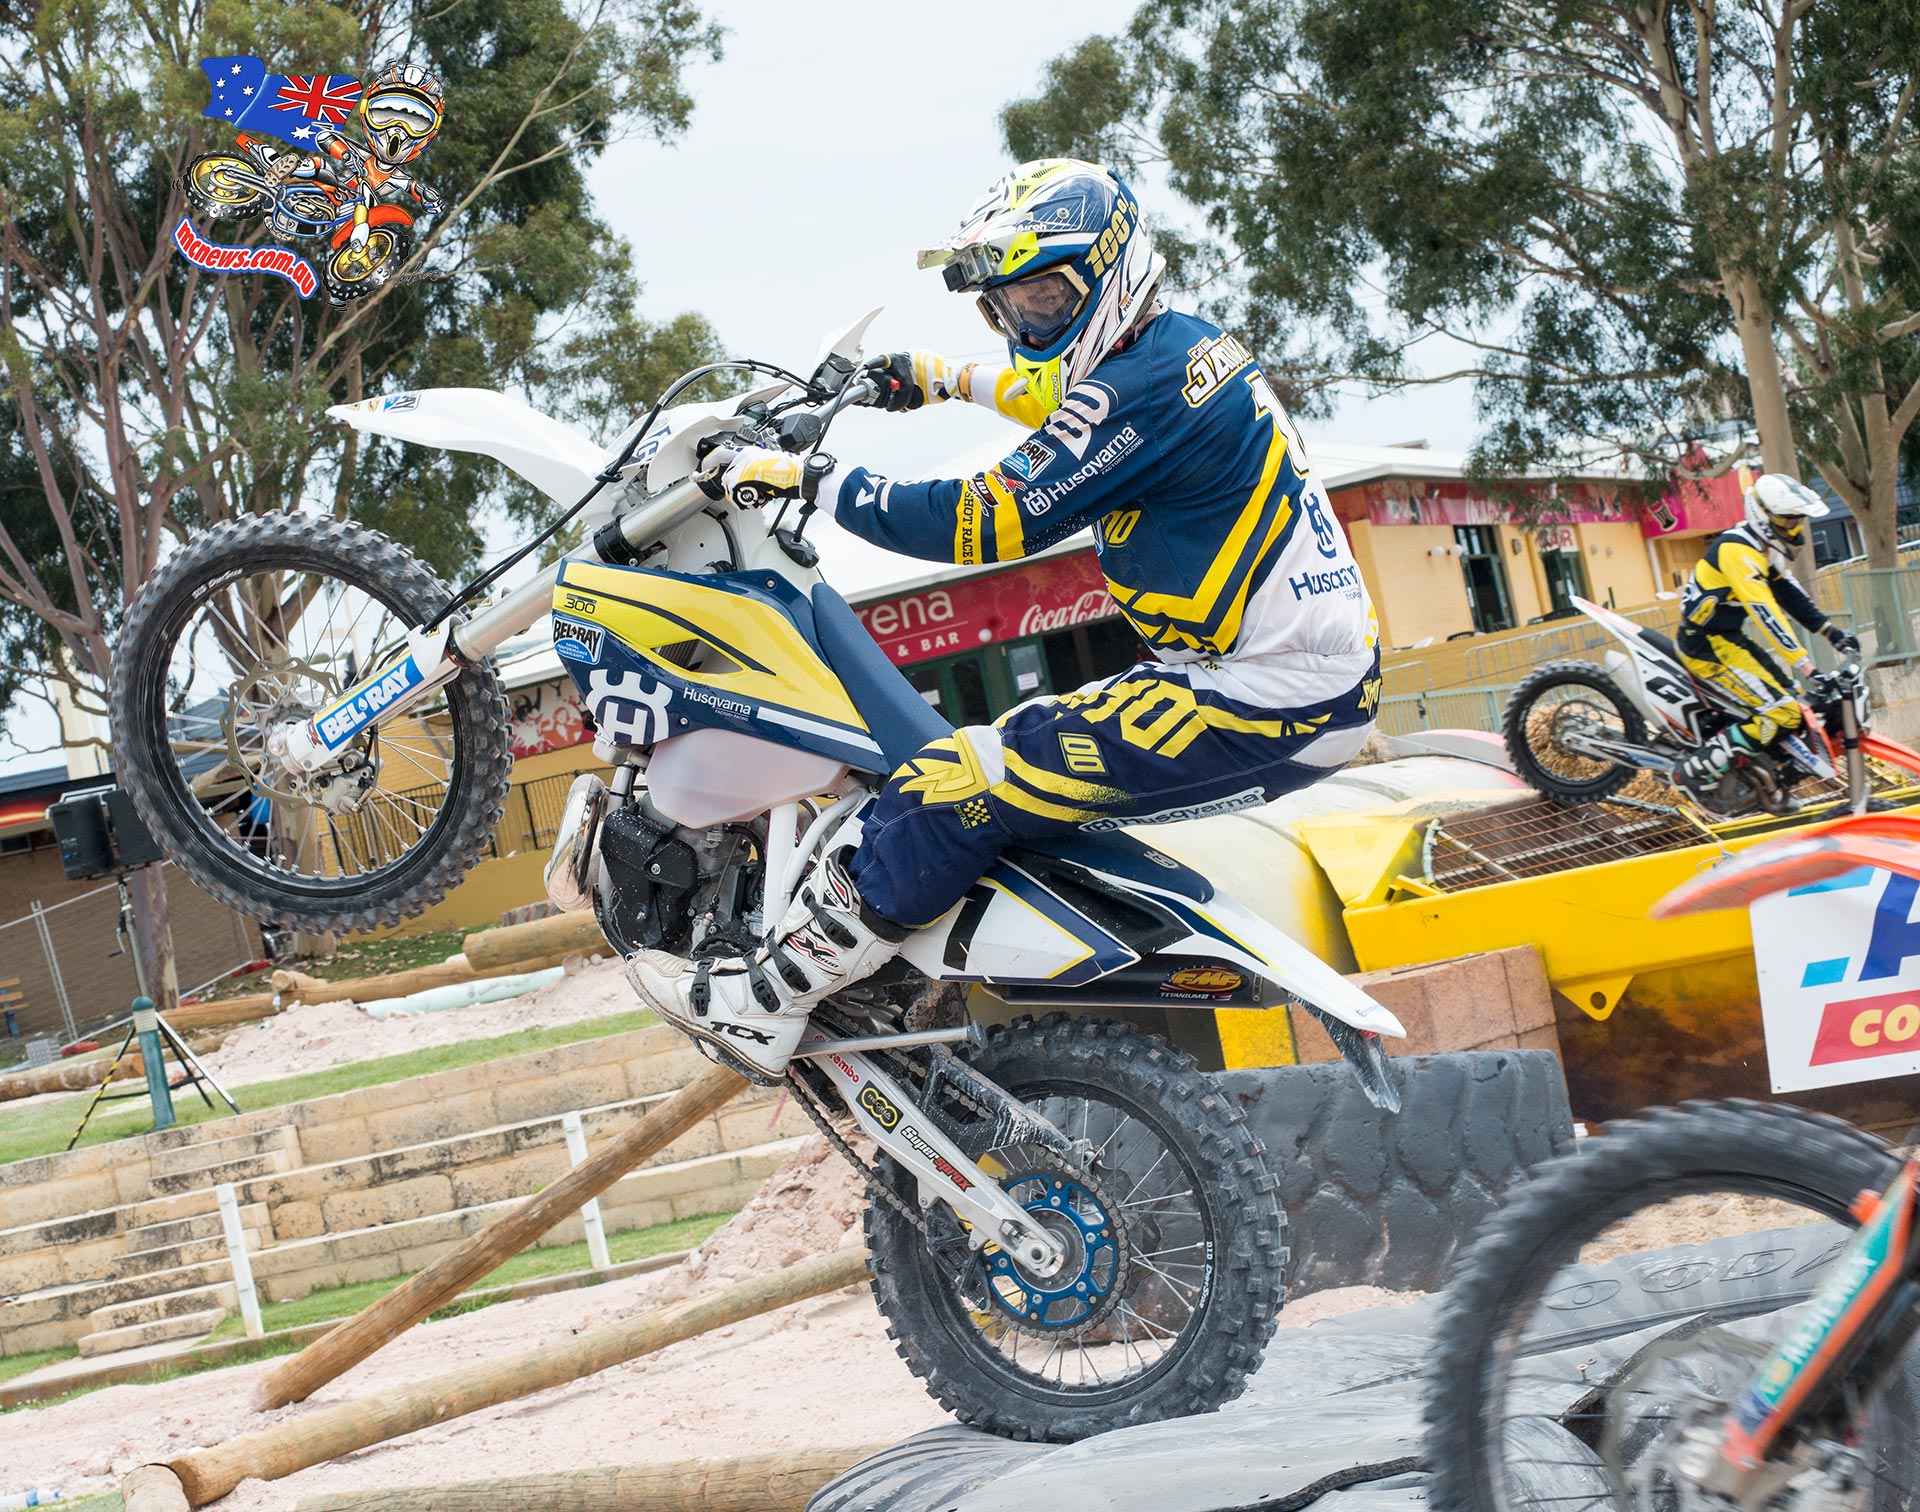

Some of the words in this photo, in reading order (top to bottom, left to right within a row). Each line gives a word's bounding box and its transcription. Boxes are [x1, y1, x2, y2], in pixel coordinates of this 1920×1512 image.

[1085, 193, 1139, 278] 100%
[1048, 424, 1138, 502] Husqvarna
[962, 527, 974, 557] RACE
[564, 600, 596, 614] 300
[921, 631, 960, 652] BAR
[683, 687, 752, 715] Husqvarna
[1172, 971, 1241, 986] FMF
[710, 1020, 775, 1045] TCX
[1850, 1003, 1920, 1048] CO
